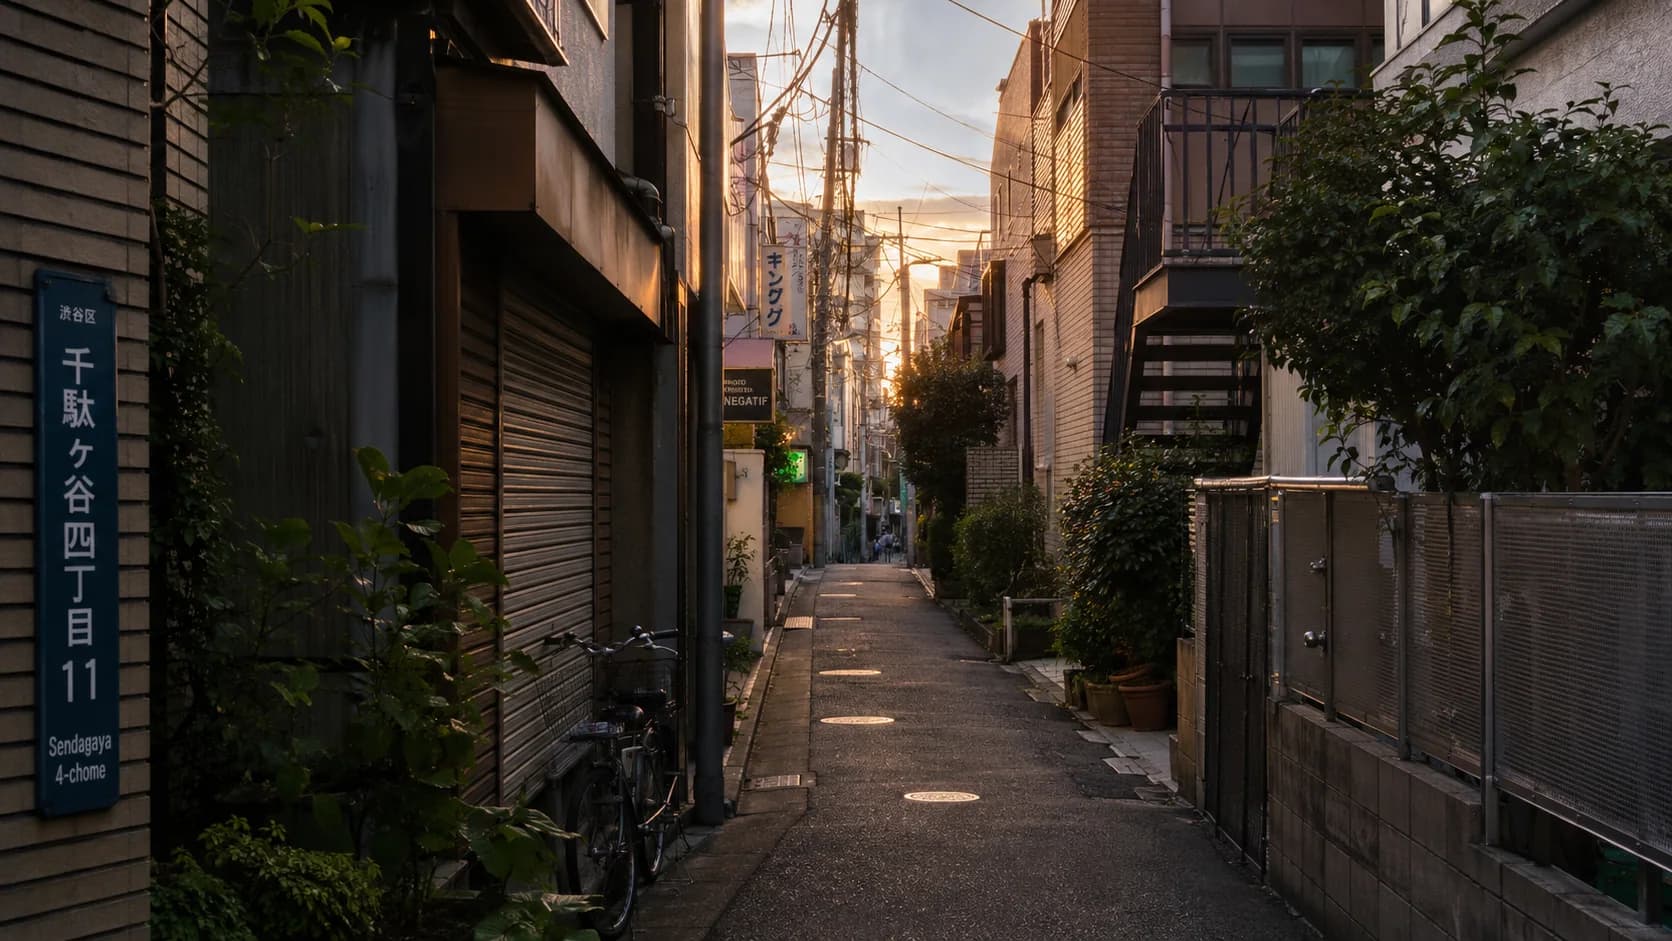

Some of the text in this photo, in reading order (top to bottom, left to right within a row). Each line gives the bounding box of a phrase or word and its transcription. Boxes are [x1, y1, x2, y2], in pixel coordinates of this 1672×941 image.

[59, 304, 97, 325] 渋谷区
[724, 396, 768, 406] NEGATIF
[62, 657, 97, 703] 11
[49, 733, 112, 756] Sendagaya
[55, 761, 106, 785] 4-chome
